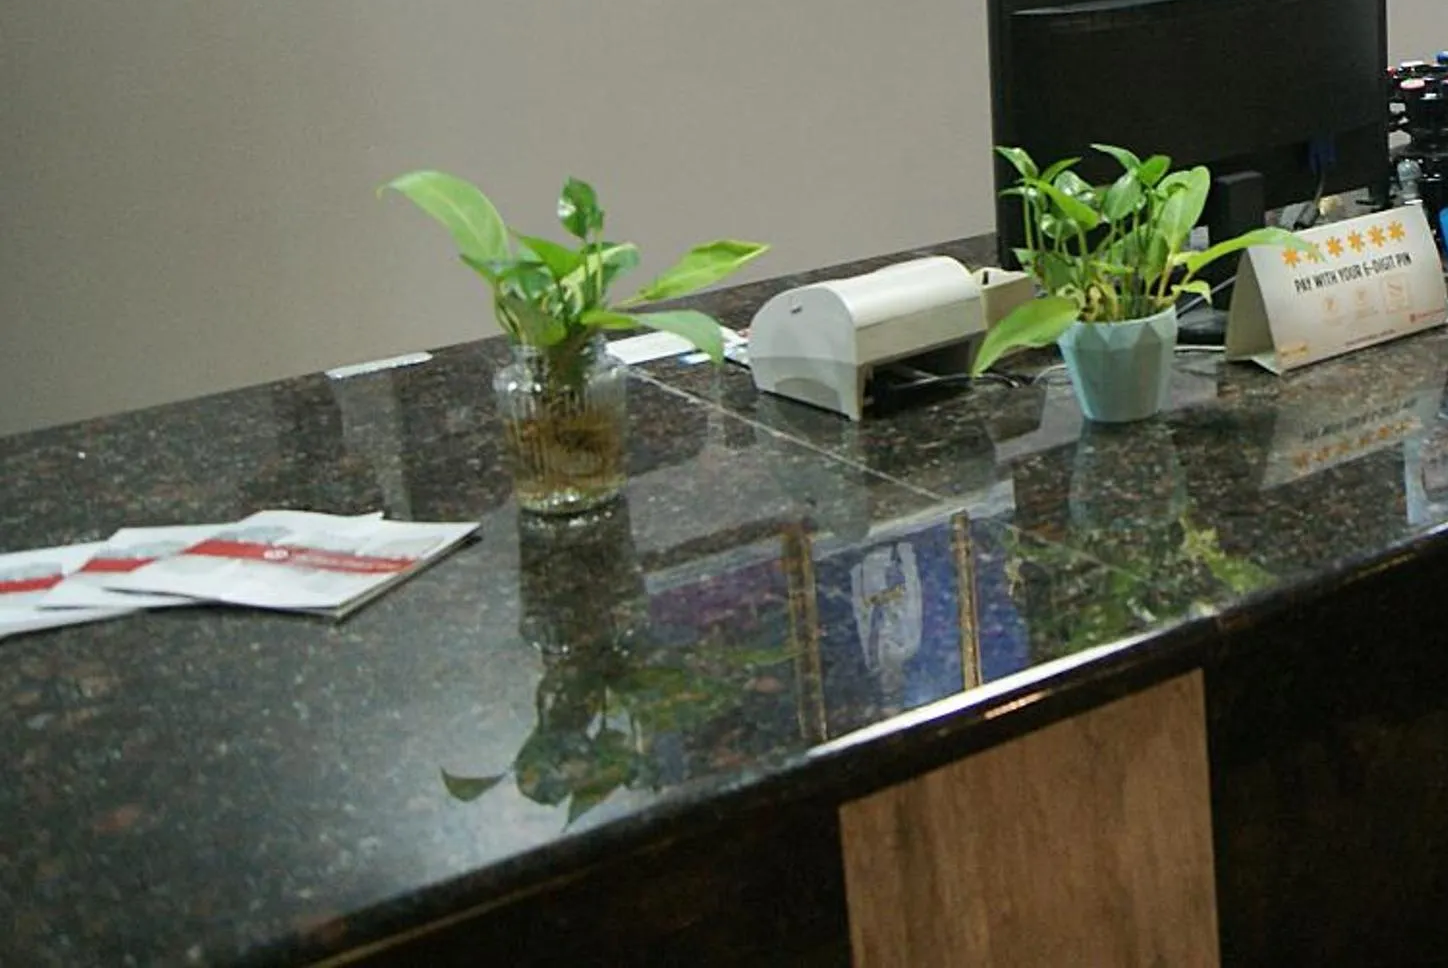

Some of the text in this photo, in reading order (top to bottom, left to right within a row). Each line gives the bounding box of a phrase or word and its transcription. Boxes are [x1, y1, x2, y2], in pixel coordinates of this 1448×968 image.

[1294, 251, 1413, 293] PAY WITH YOUR 6-DIGIT PIN
